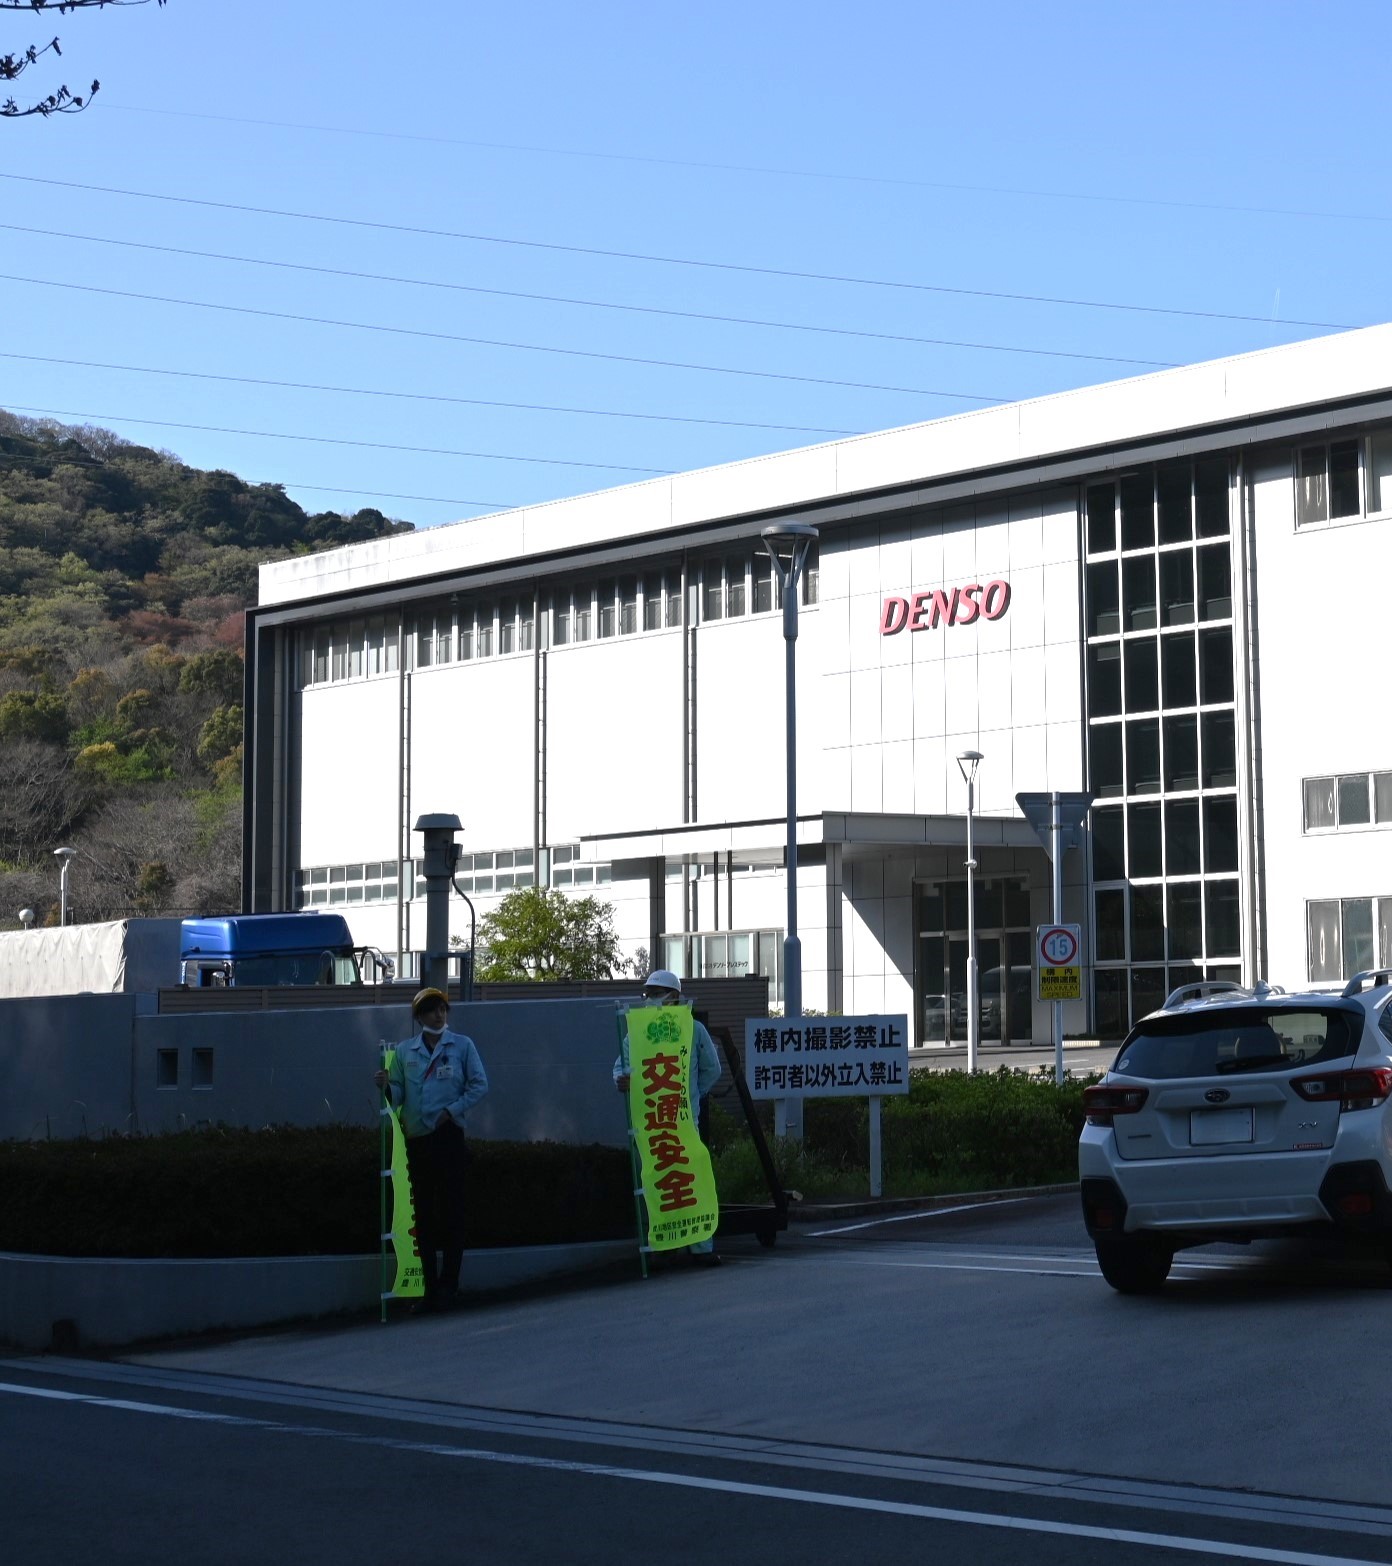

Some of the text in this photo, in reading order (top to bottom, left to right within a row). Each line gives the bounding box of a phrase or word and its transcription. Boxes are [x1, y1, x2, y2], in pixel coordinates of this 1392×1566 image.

[879, 580, 1010, 636] DENSO
[1050, 939, 1068, 956] 15
[754, 1024, 902, 1054] 構内撮影禁止
[754, 1061, 903, 1091] 許可者以外立入禁止
[642, 1052, 698, 1212] 交通安全
